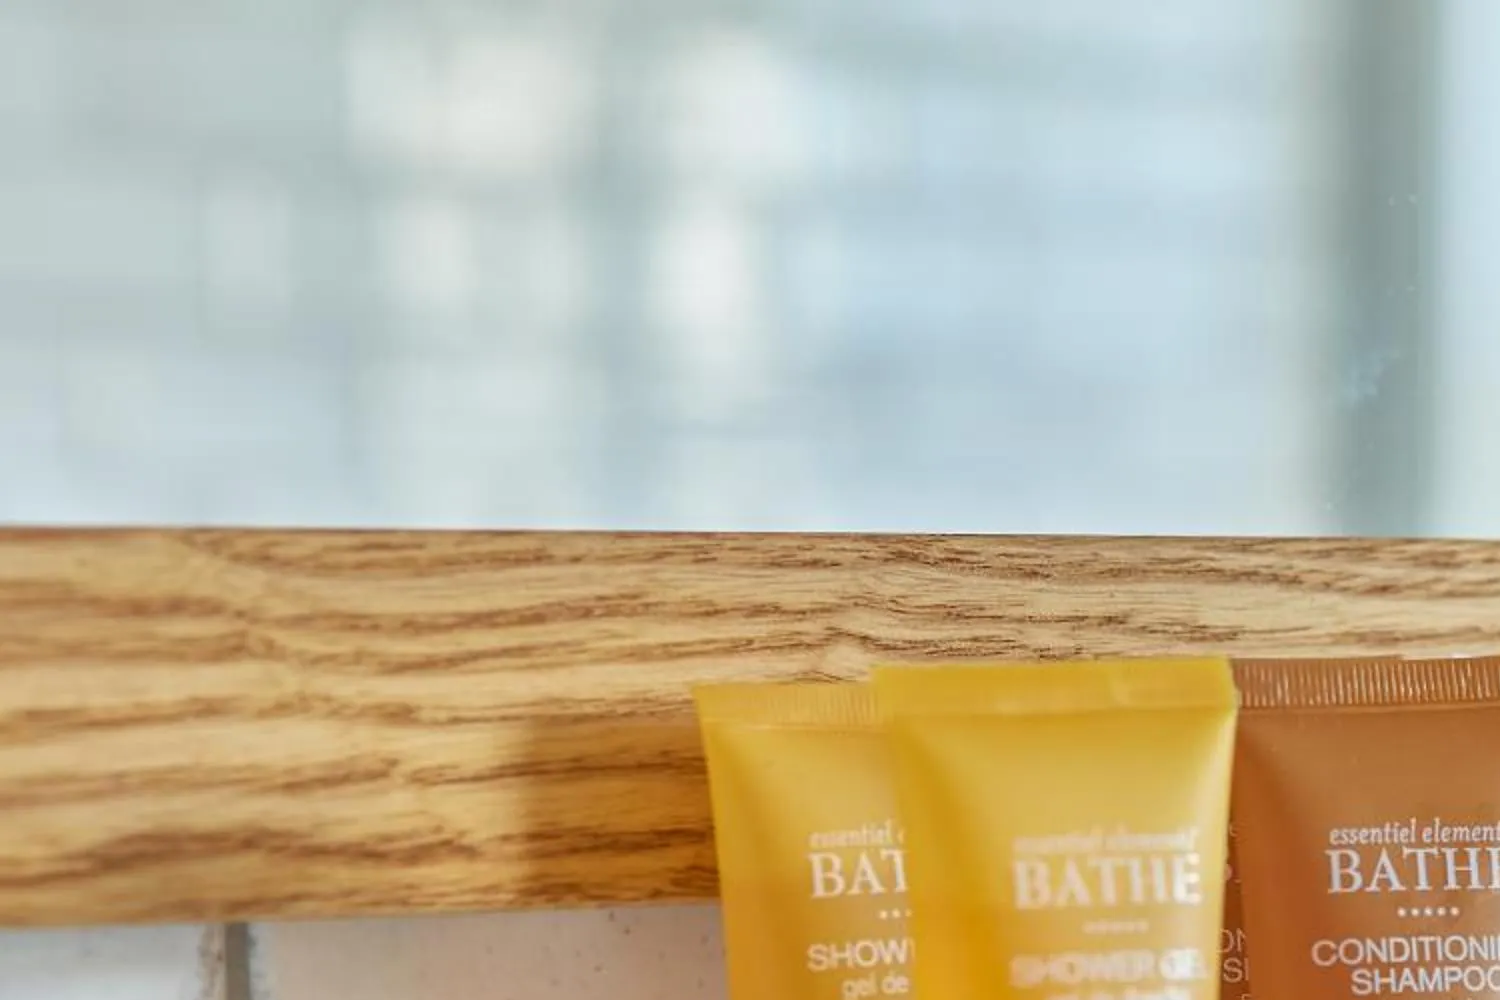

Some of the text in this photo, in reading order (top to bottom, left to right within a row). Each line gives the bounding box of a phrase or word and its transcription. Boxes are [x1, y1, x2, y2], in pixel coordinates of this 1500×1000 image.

[1329, 817, 1416, 845] essentiel
[807, 849, 908, 898] BAT
[1013, 852, 1201, 909] BATHE
[807, 938, 916, 972] SHOW
[882, 970, 909, 994] de
